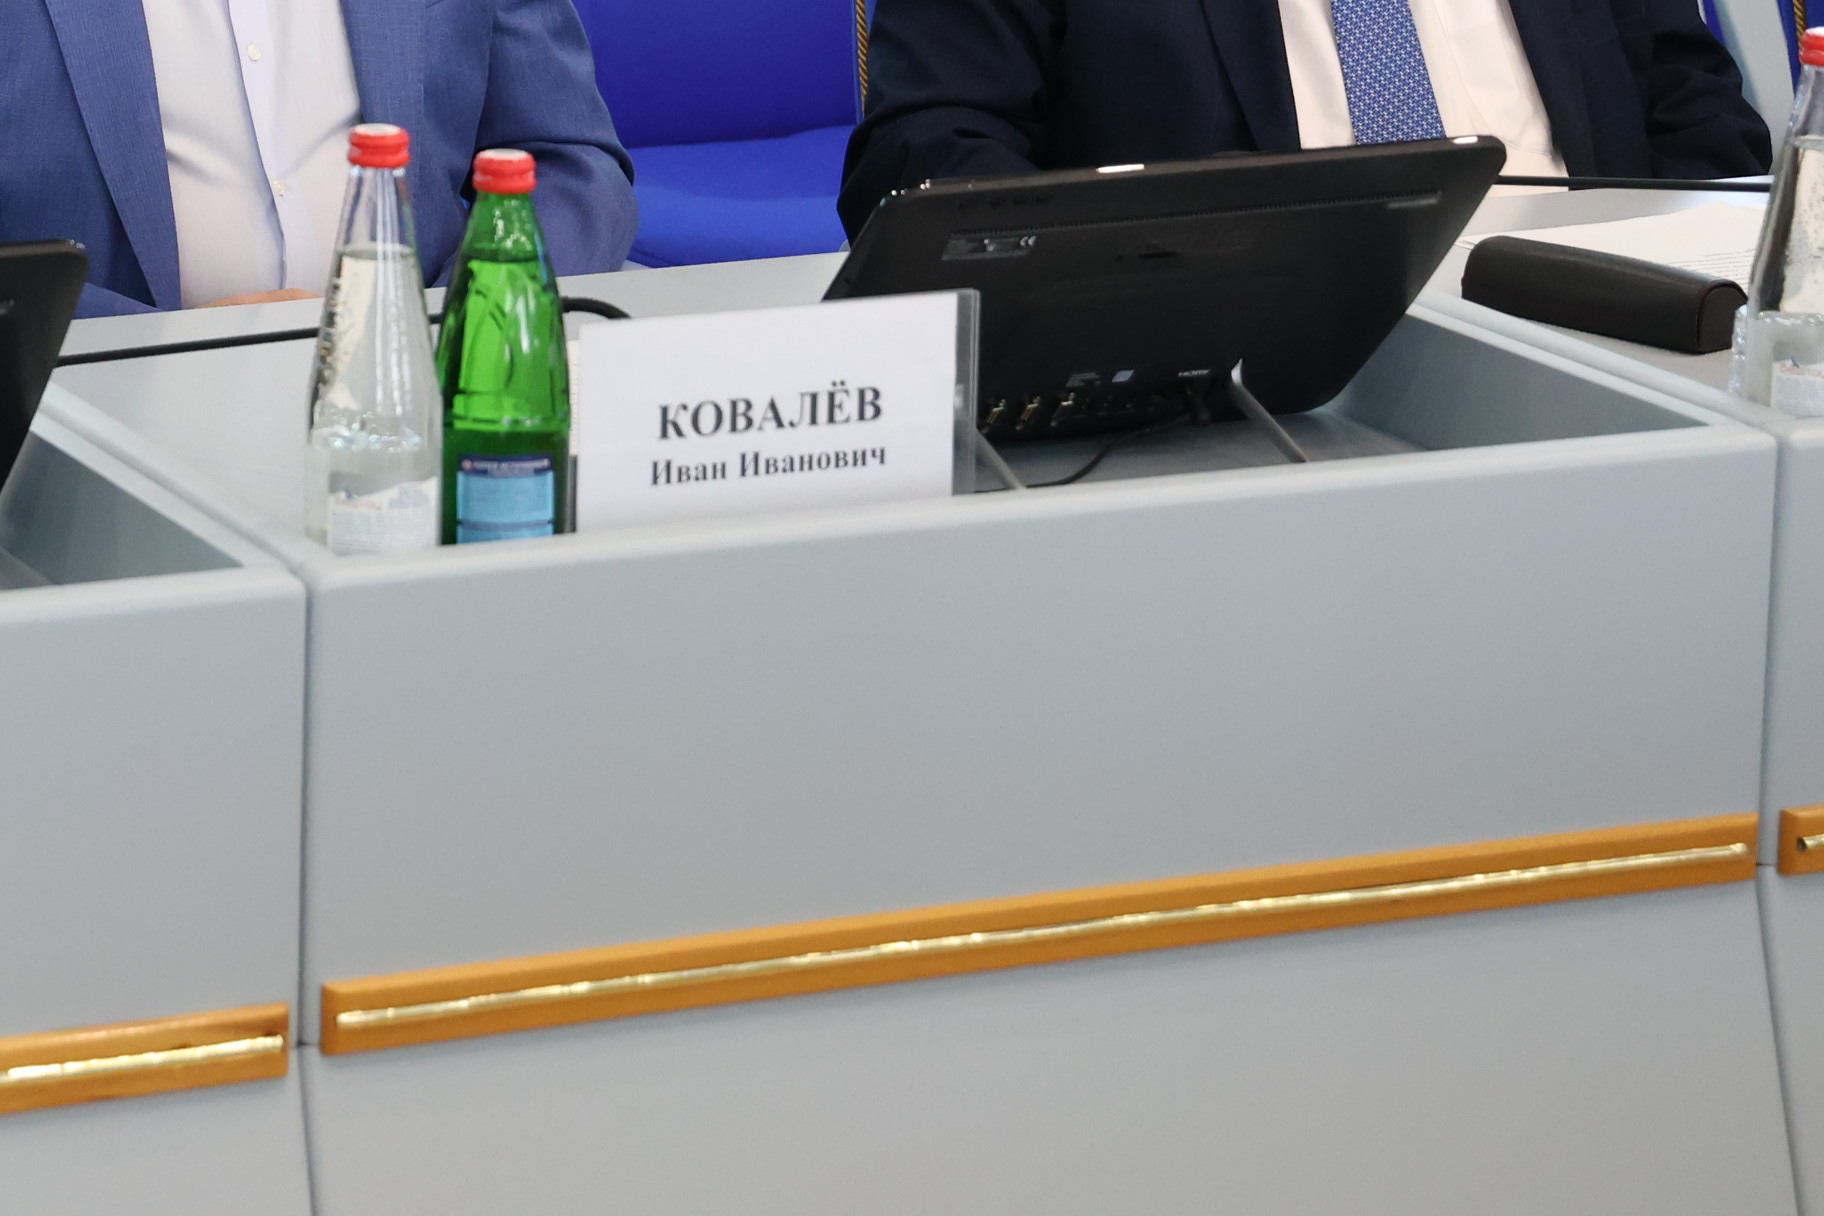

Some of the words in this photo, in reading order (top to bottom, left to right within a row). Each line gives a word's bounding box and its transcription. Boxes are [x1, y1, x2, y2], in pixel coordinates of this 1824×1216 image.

[657, 379, 883, 441] КОВАЛЁВ
[650, 458, 727, 486] Иван
[738, 447, 887, 479] Иванович
